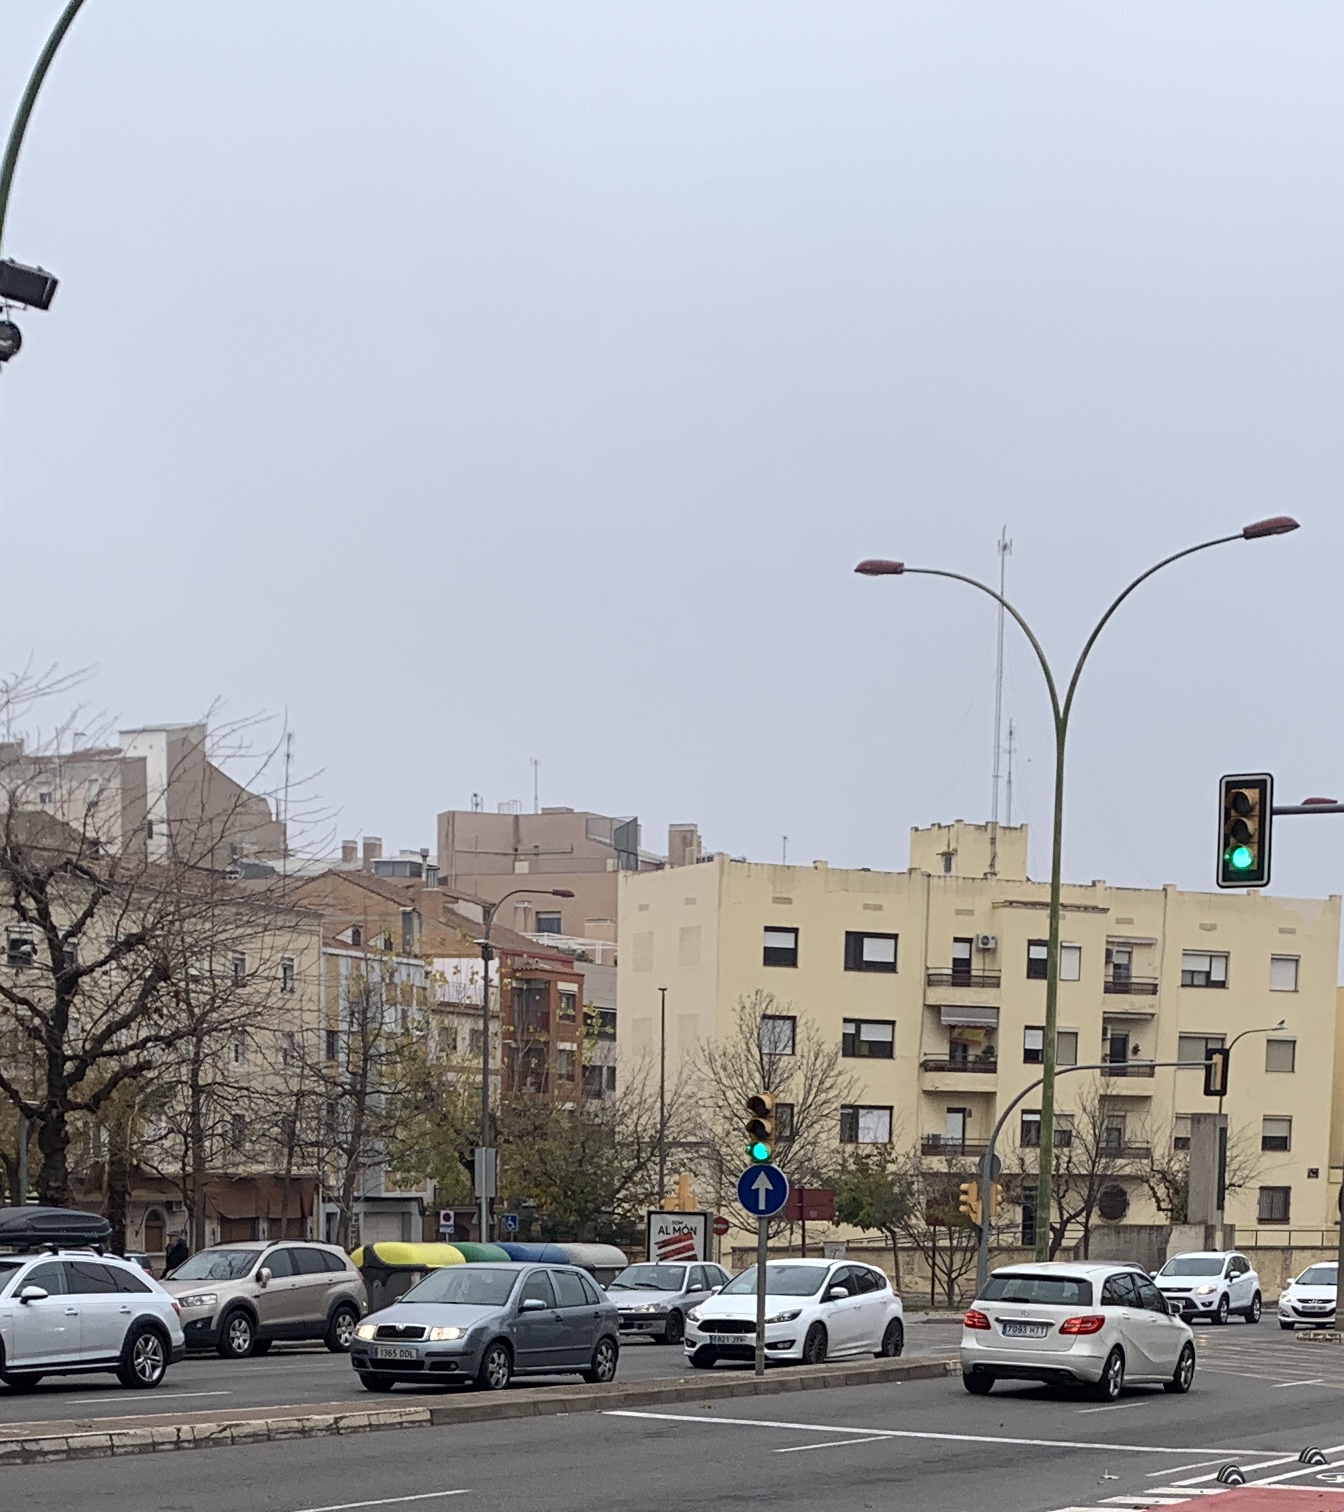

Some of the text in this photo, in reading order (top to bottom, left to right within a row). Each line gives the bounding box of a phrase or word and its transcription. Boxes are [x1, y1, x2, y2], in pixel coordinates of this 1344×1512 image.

[658, 1224, 697, 1235] AL MÓN
[1007, 1324, 1027, 1334] 7093
